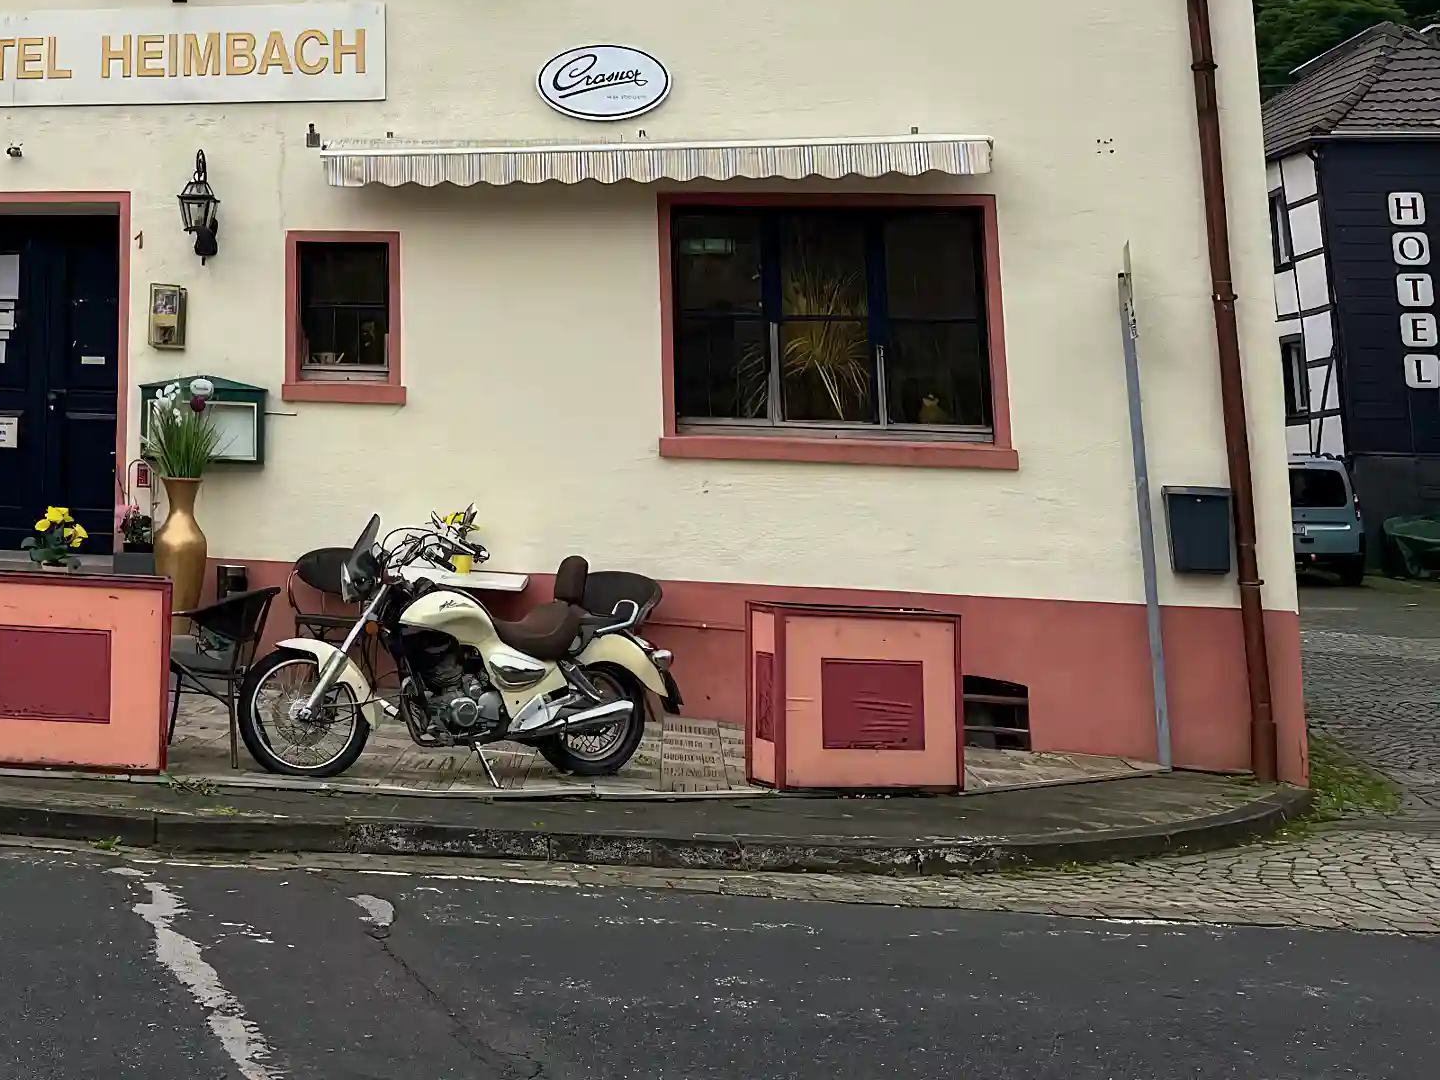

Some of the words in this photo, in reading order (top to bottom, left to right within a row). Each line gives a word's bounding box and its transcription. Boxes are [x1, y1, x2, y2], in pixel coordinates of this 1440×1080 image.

[101, 28, 367, 80] HEIMBACH
[134, 230, 144, 250] 1
[1394, 196, 1432, 384] HOTEL
